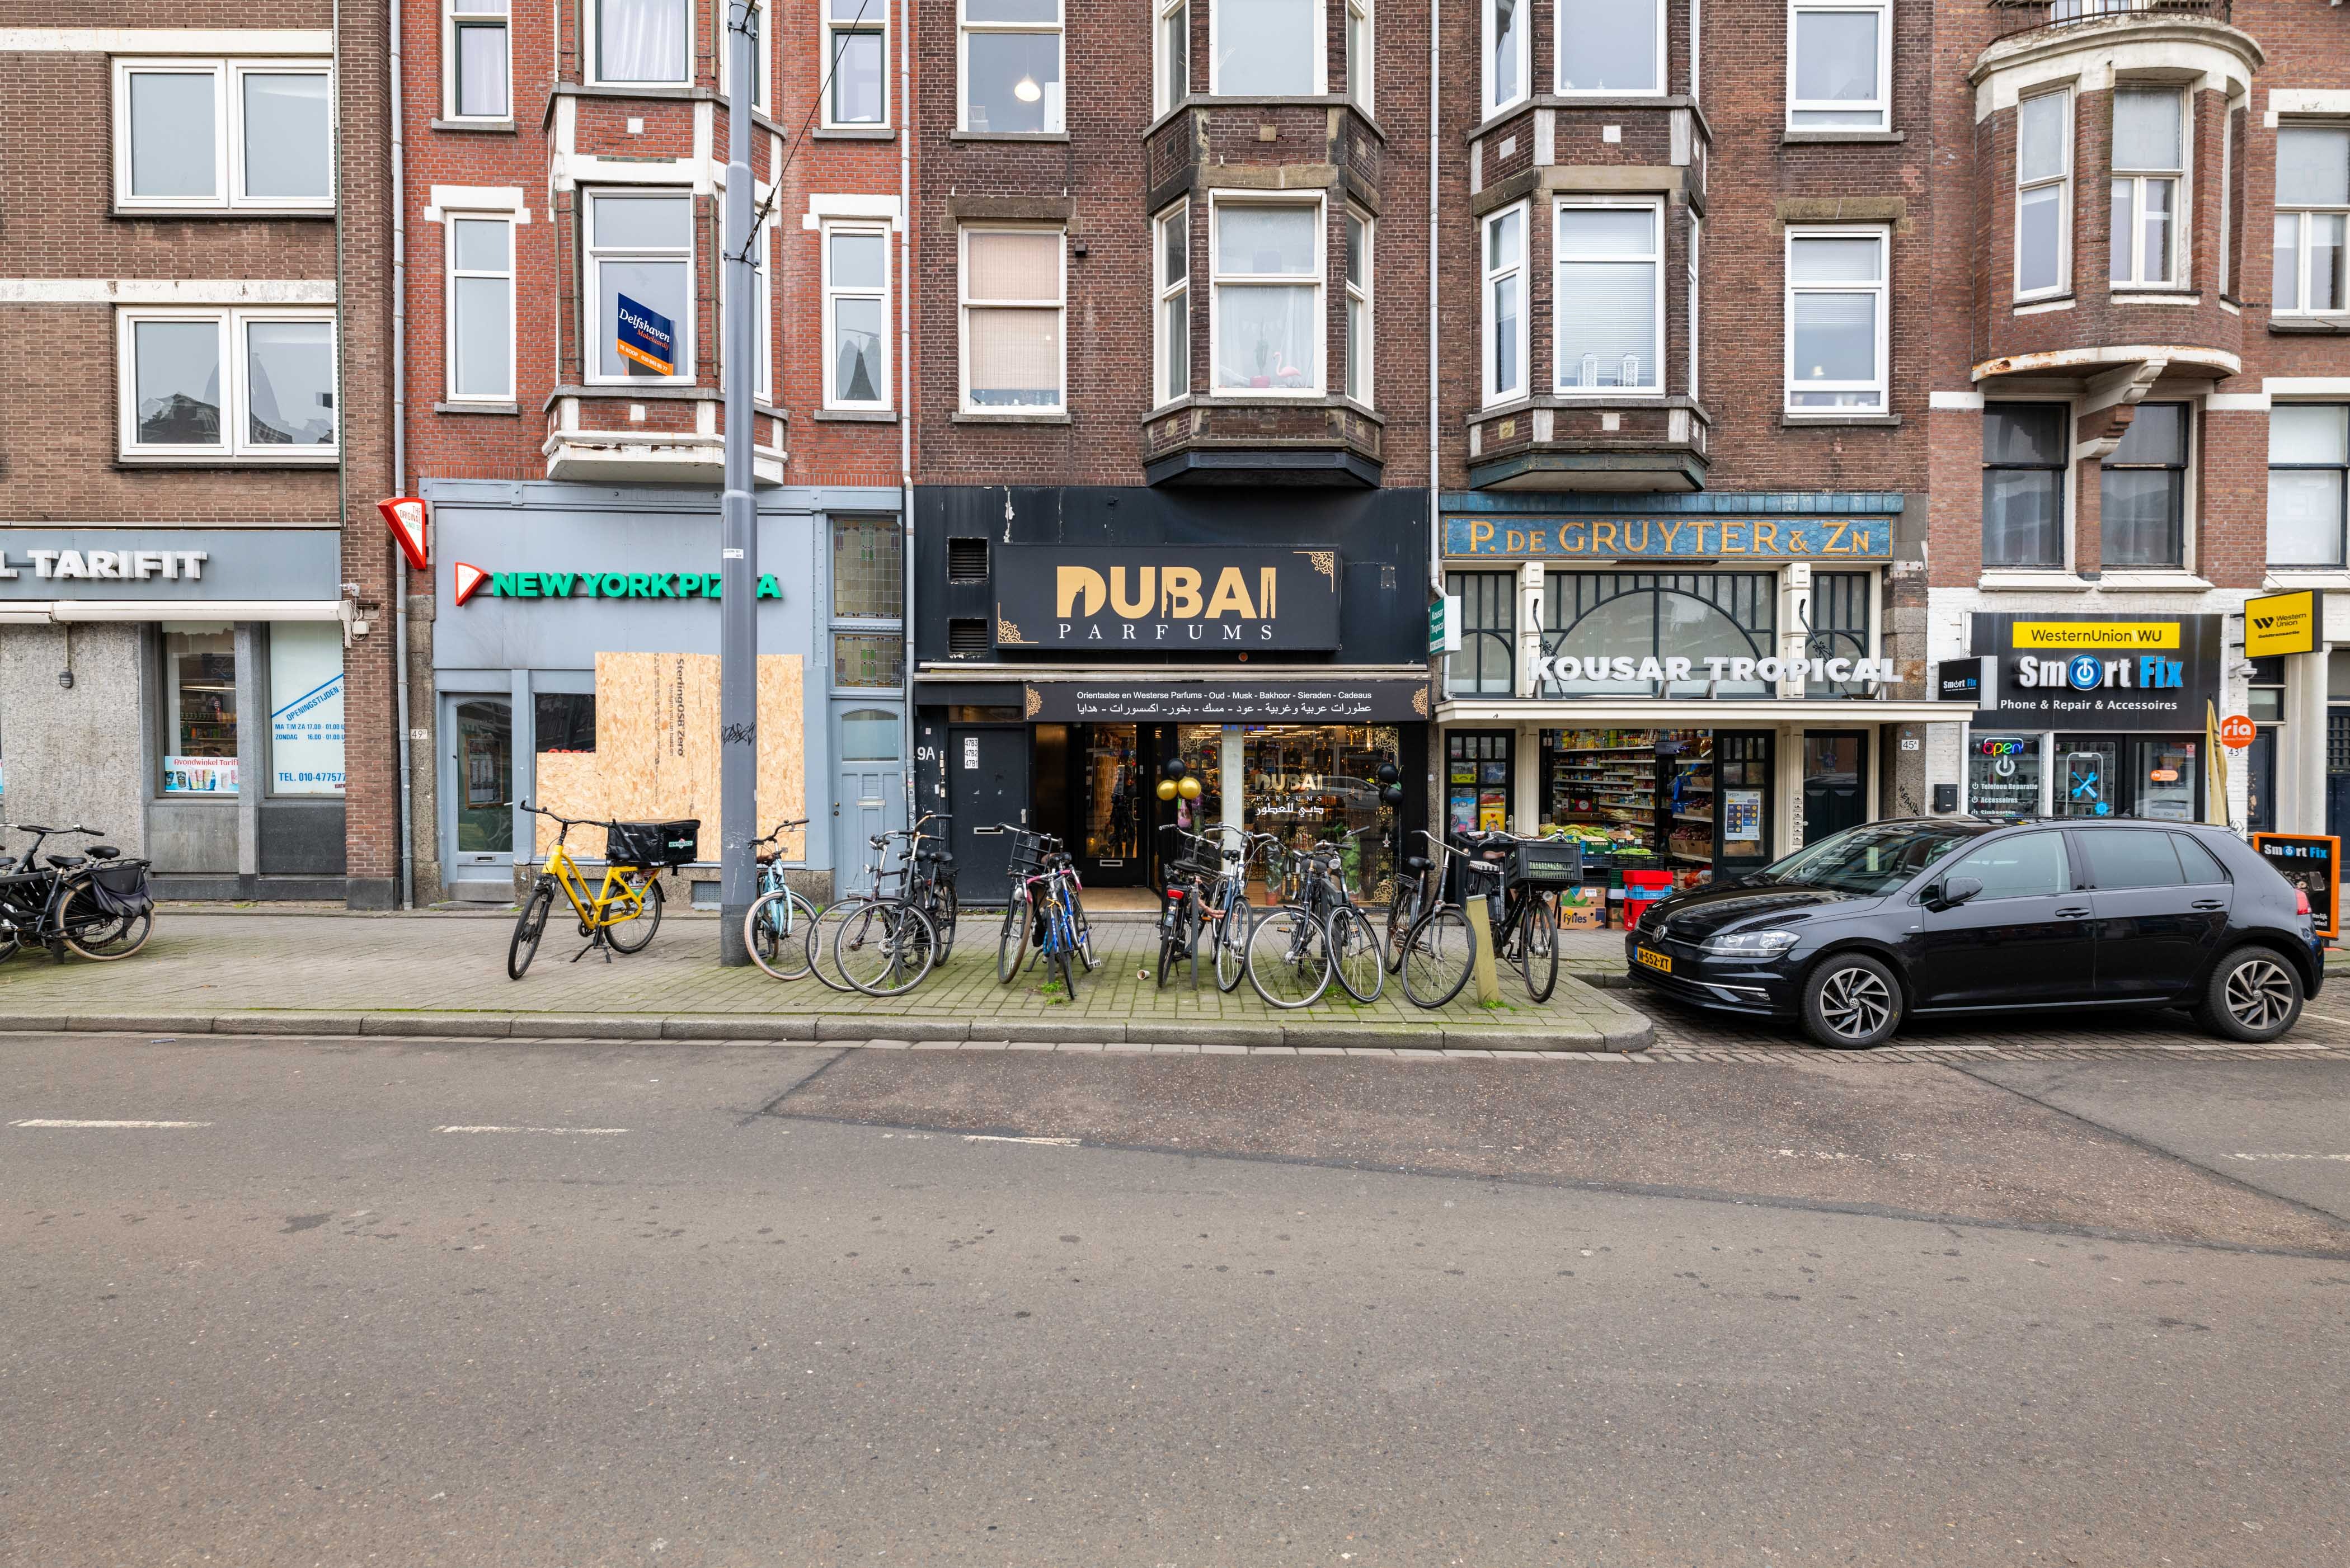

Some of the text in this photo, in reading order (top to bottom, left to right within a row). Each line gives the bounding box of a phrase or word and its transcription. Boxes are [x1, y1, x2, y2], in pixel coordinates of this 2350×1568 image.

[619, 308, 670, 342] Delfshaven
[637, 329, 669, 351] Makelaardij
[626, 347, 638, 357] KOOP
[641, 355, 649, 363] 010
[400, 510, 421, 524] ORIGINAL
[412, 506, 421, 516] THE
[1469, 521, 1496, 553] P.
[1559, 521, 1780, 553] GRUYTER
[1788, 530, 1810, 553] &
[27, 550, 208, 579] TARIFIT
[493, 572, 579, 597] NEW
[580, 572, 677, 598] YORK
[679, 573, 782, 599] PIZA
[1056, 566, 1276, 619] DUBAI
[1431, 608, 1444, 621] Kousar
[2276, 613, 2306, 621] Western
[1058, 623, 1272, 640] PARFUMS
[1431, 618, 1444, 634] Tropical
[2258, 630, 2300, 639] Geldtransactie
[1528, 656, 1904, 683] KOUSAR TROPICAL
[2139, 655, 2184, 688] Fix
[1967, 677, 1977, 687] Fix
[286, 686, 340, 722] OPENINGSTIJDEN
[1077, 703, 1098, 715] هدايا
[1202, 703, 1224, 713] مسك
[1237, 705, 1254, 714] عود
[1301, 703, 1327, 714] عربية
[1331, 703, 1372, 714] عطورات
[2000, 699, 2177, 711] Phone & Repair & Accessoires
[2224, 719, 2251, 736] ria
[1903, 741, 1917, 749] 45A
[1983, 742, 2022, 757] open
[914, 746, 936, 761] 9A
[174, 758, 218, 766] Avondwinkel
[278, 773, 297, 781] TEL.
[1255, 774, 1323, 790] DUBAI
[2309, 847, 2328, 859] Fix
[1639, 950, 1669, 970] N-552-XT
